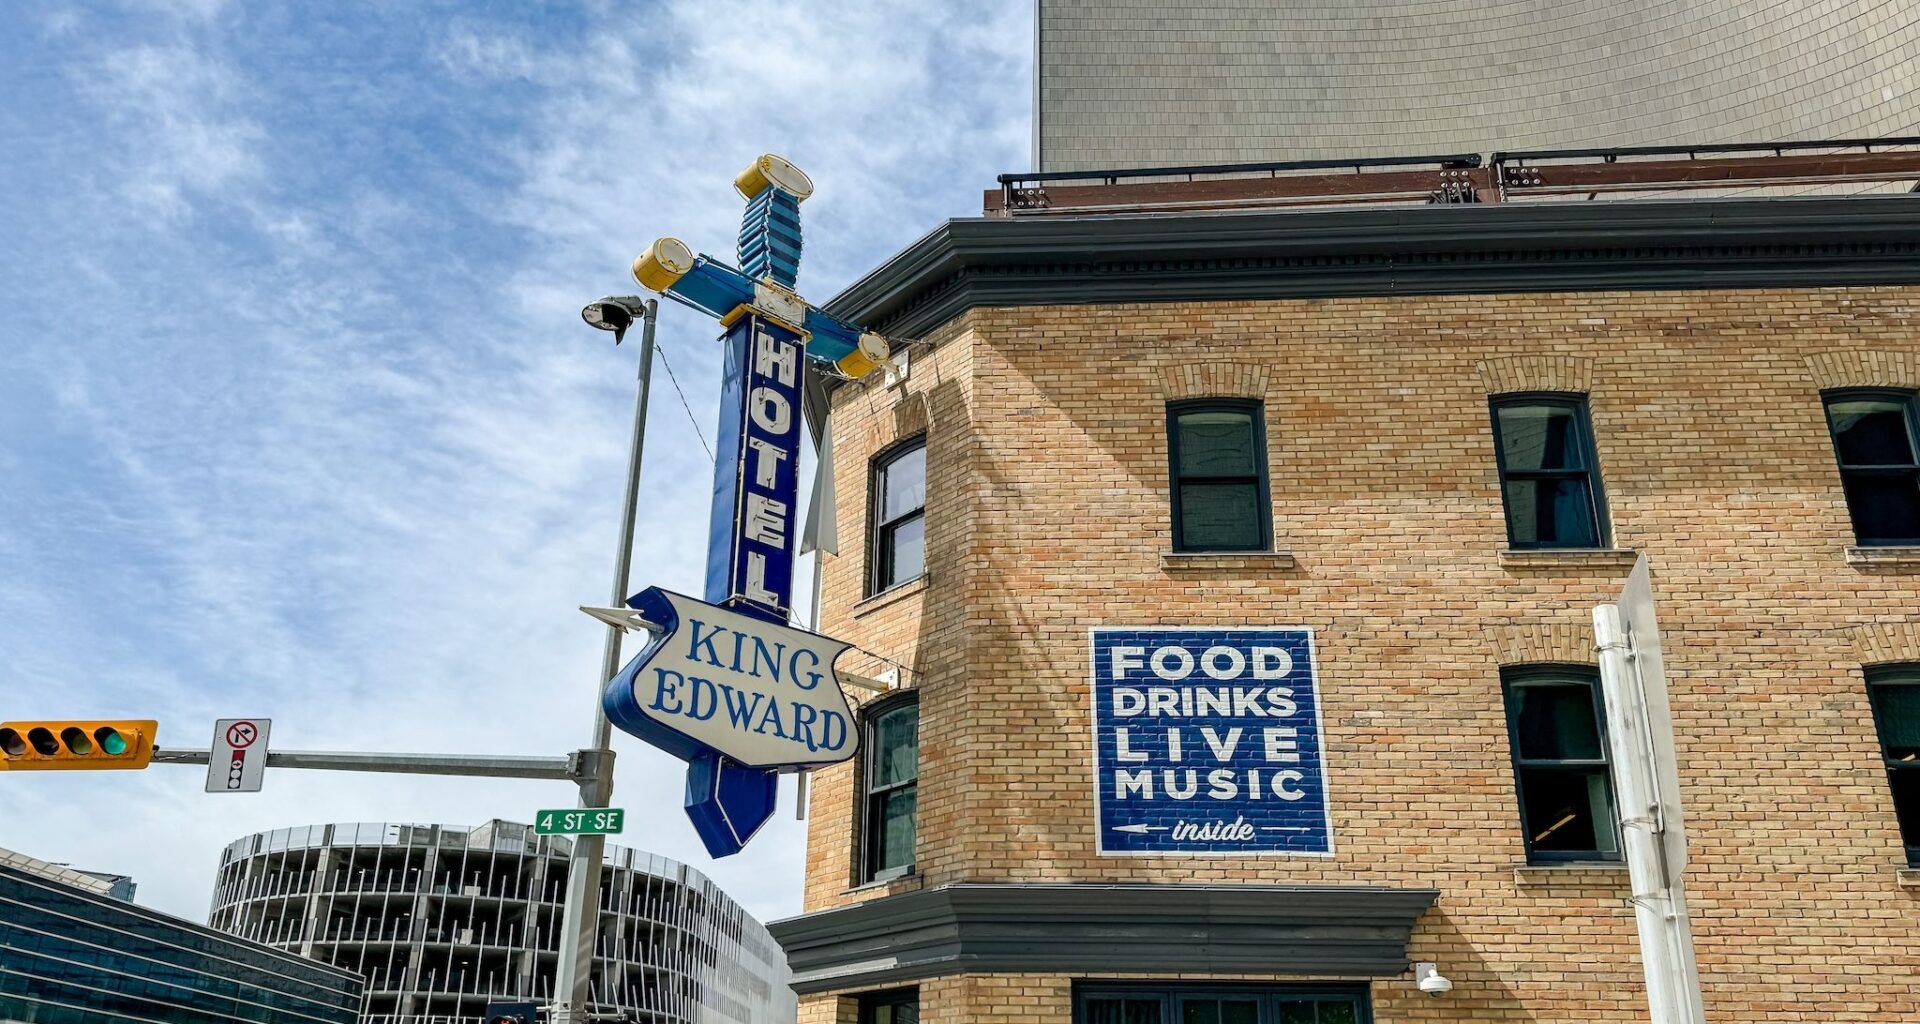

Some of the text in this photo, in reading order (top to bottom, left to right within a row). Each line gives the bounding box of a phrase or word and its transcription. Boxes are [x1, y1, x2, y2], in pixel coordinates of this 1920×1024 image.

[745, 331, 797, 609] HOTEL
[685, 618, 824, 690] KING
[1111, 645, 1293, 680] FOOD
[648, 667, 848, 752] EDWARD
[1113, 687, 1297, 717] DRINKS
[1116, 727, 1300, 762] LIVE
[1115, 769, 1306, 801] MUSIC
[540, 812, 618, 830] 4 ST SE
[1172, 815, 1256, 841] inside
